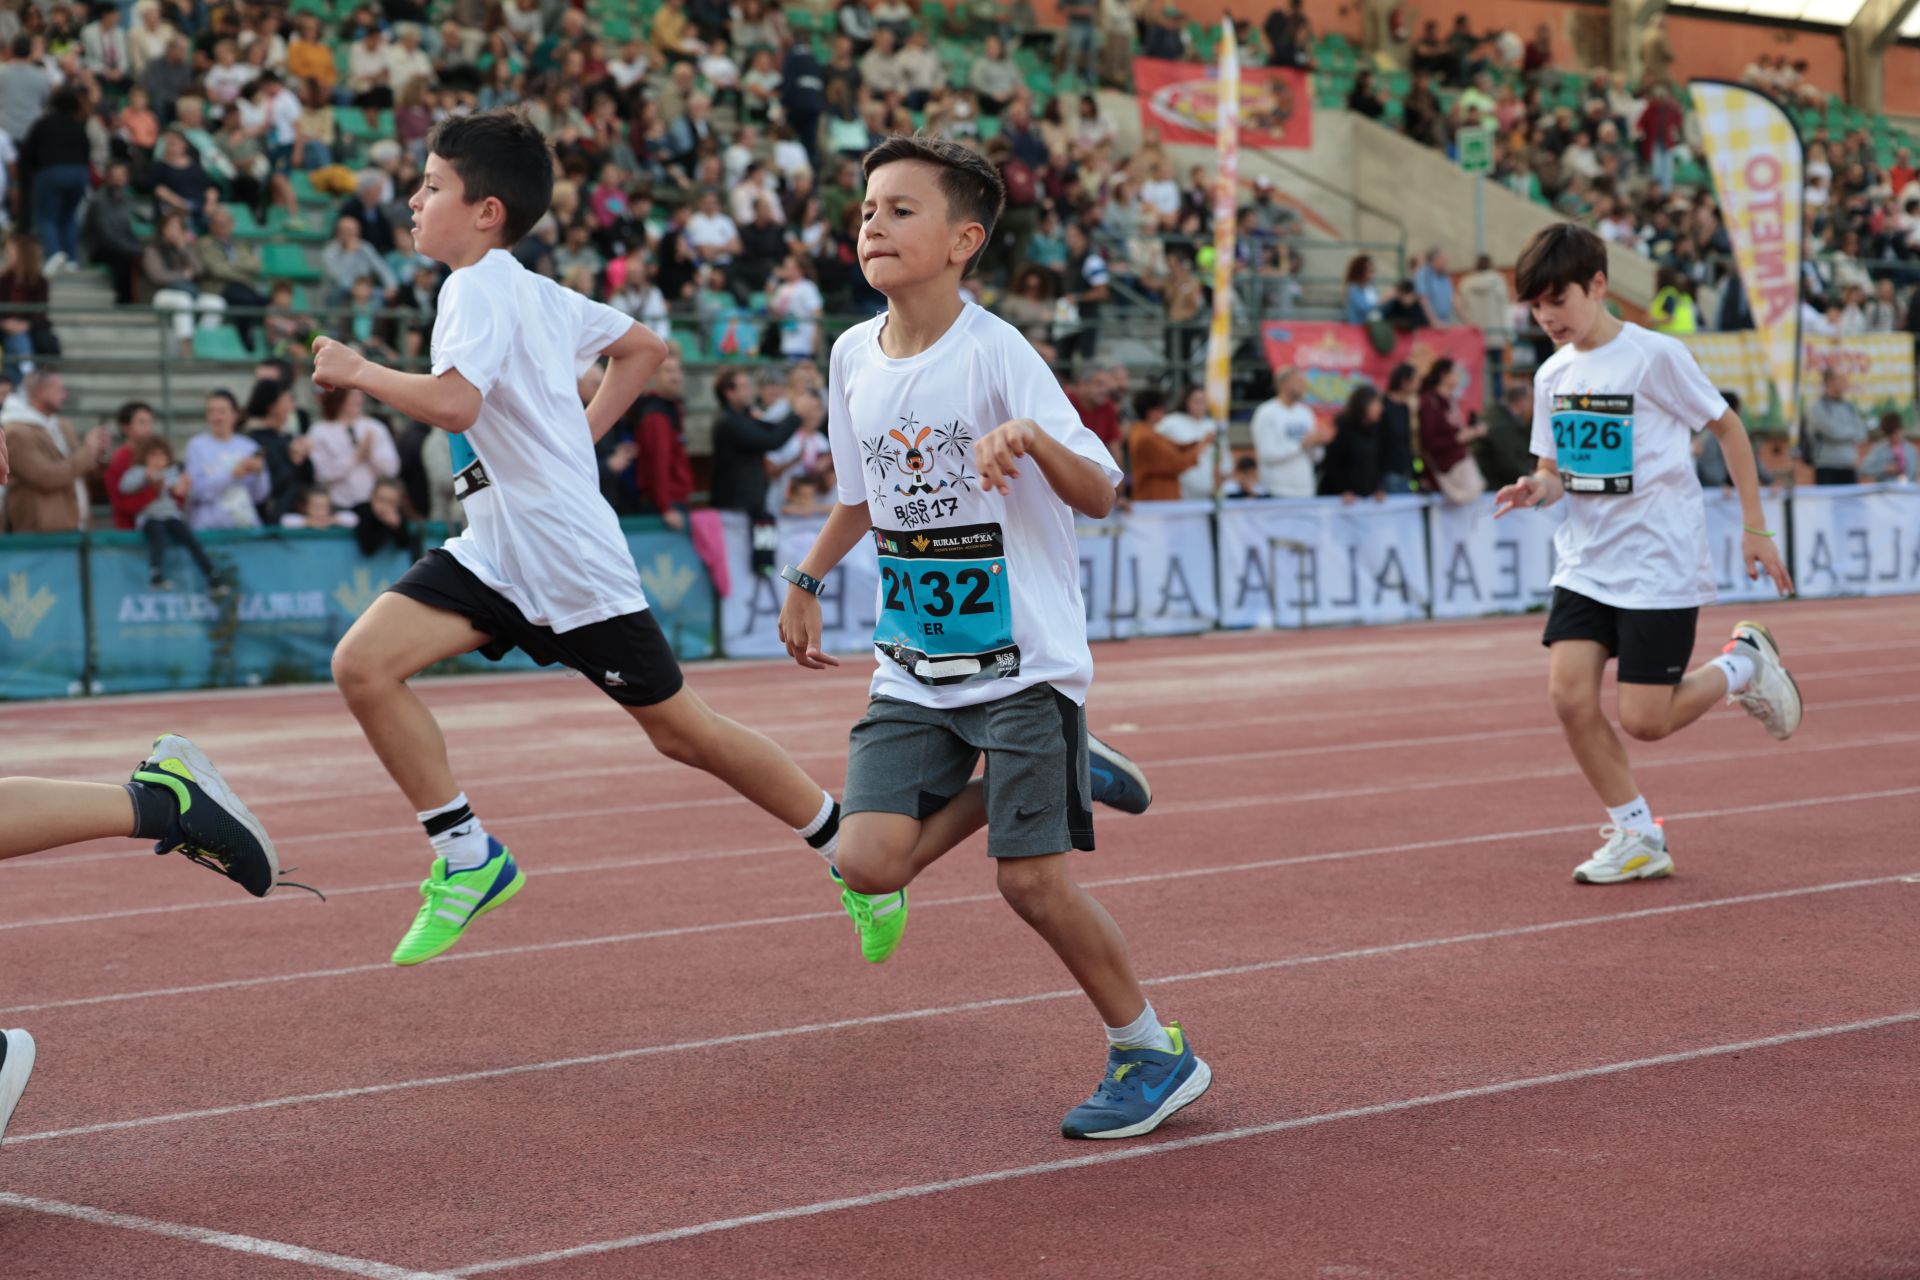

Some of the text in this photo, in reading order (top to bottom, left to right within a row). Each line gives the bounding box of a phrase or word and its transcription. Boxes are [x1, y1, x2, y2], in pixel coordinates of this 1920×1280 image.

[1554, 420, 1622, 450] 2126
[894, 497, 958, 520] BISS 17
[932, 534, 993, 547] RURAL KUTXA
[883, 566, 994, 617] 2132
